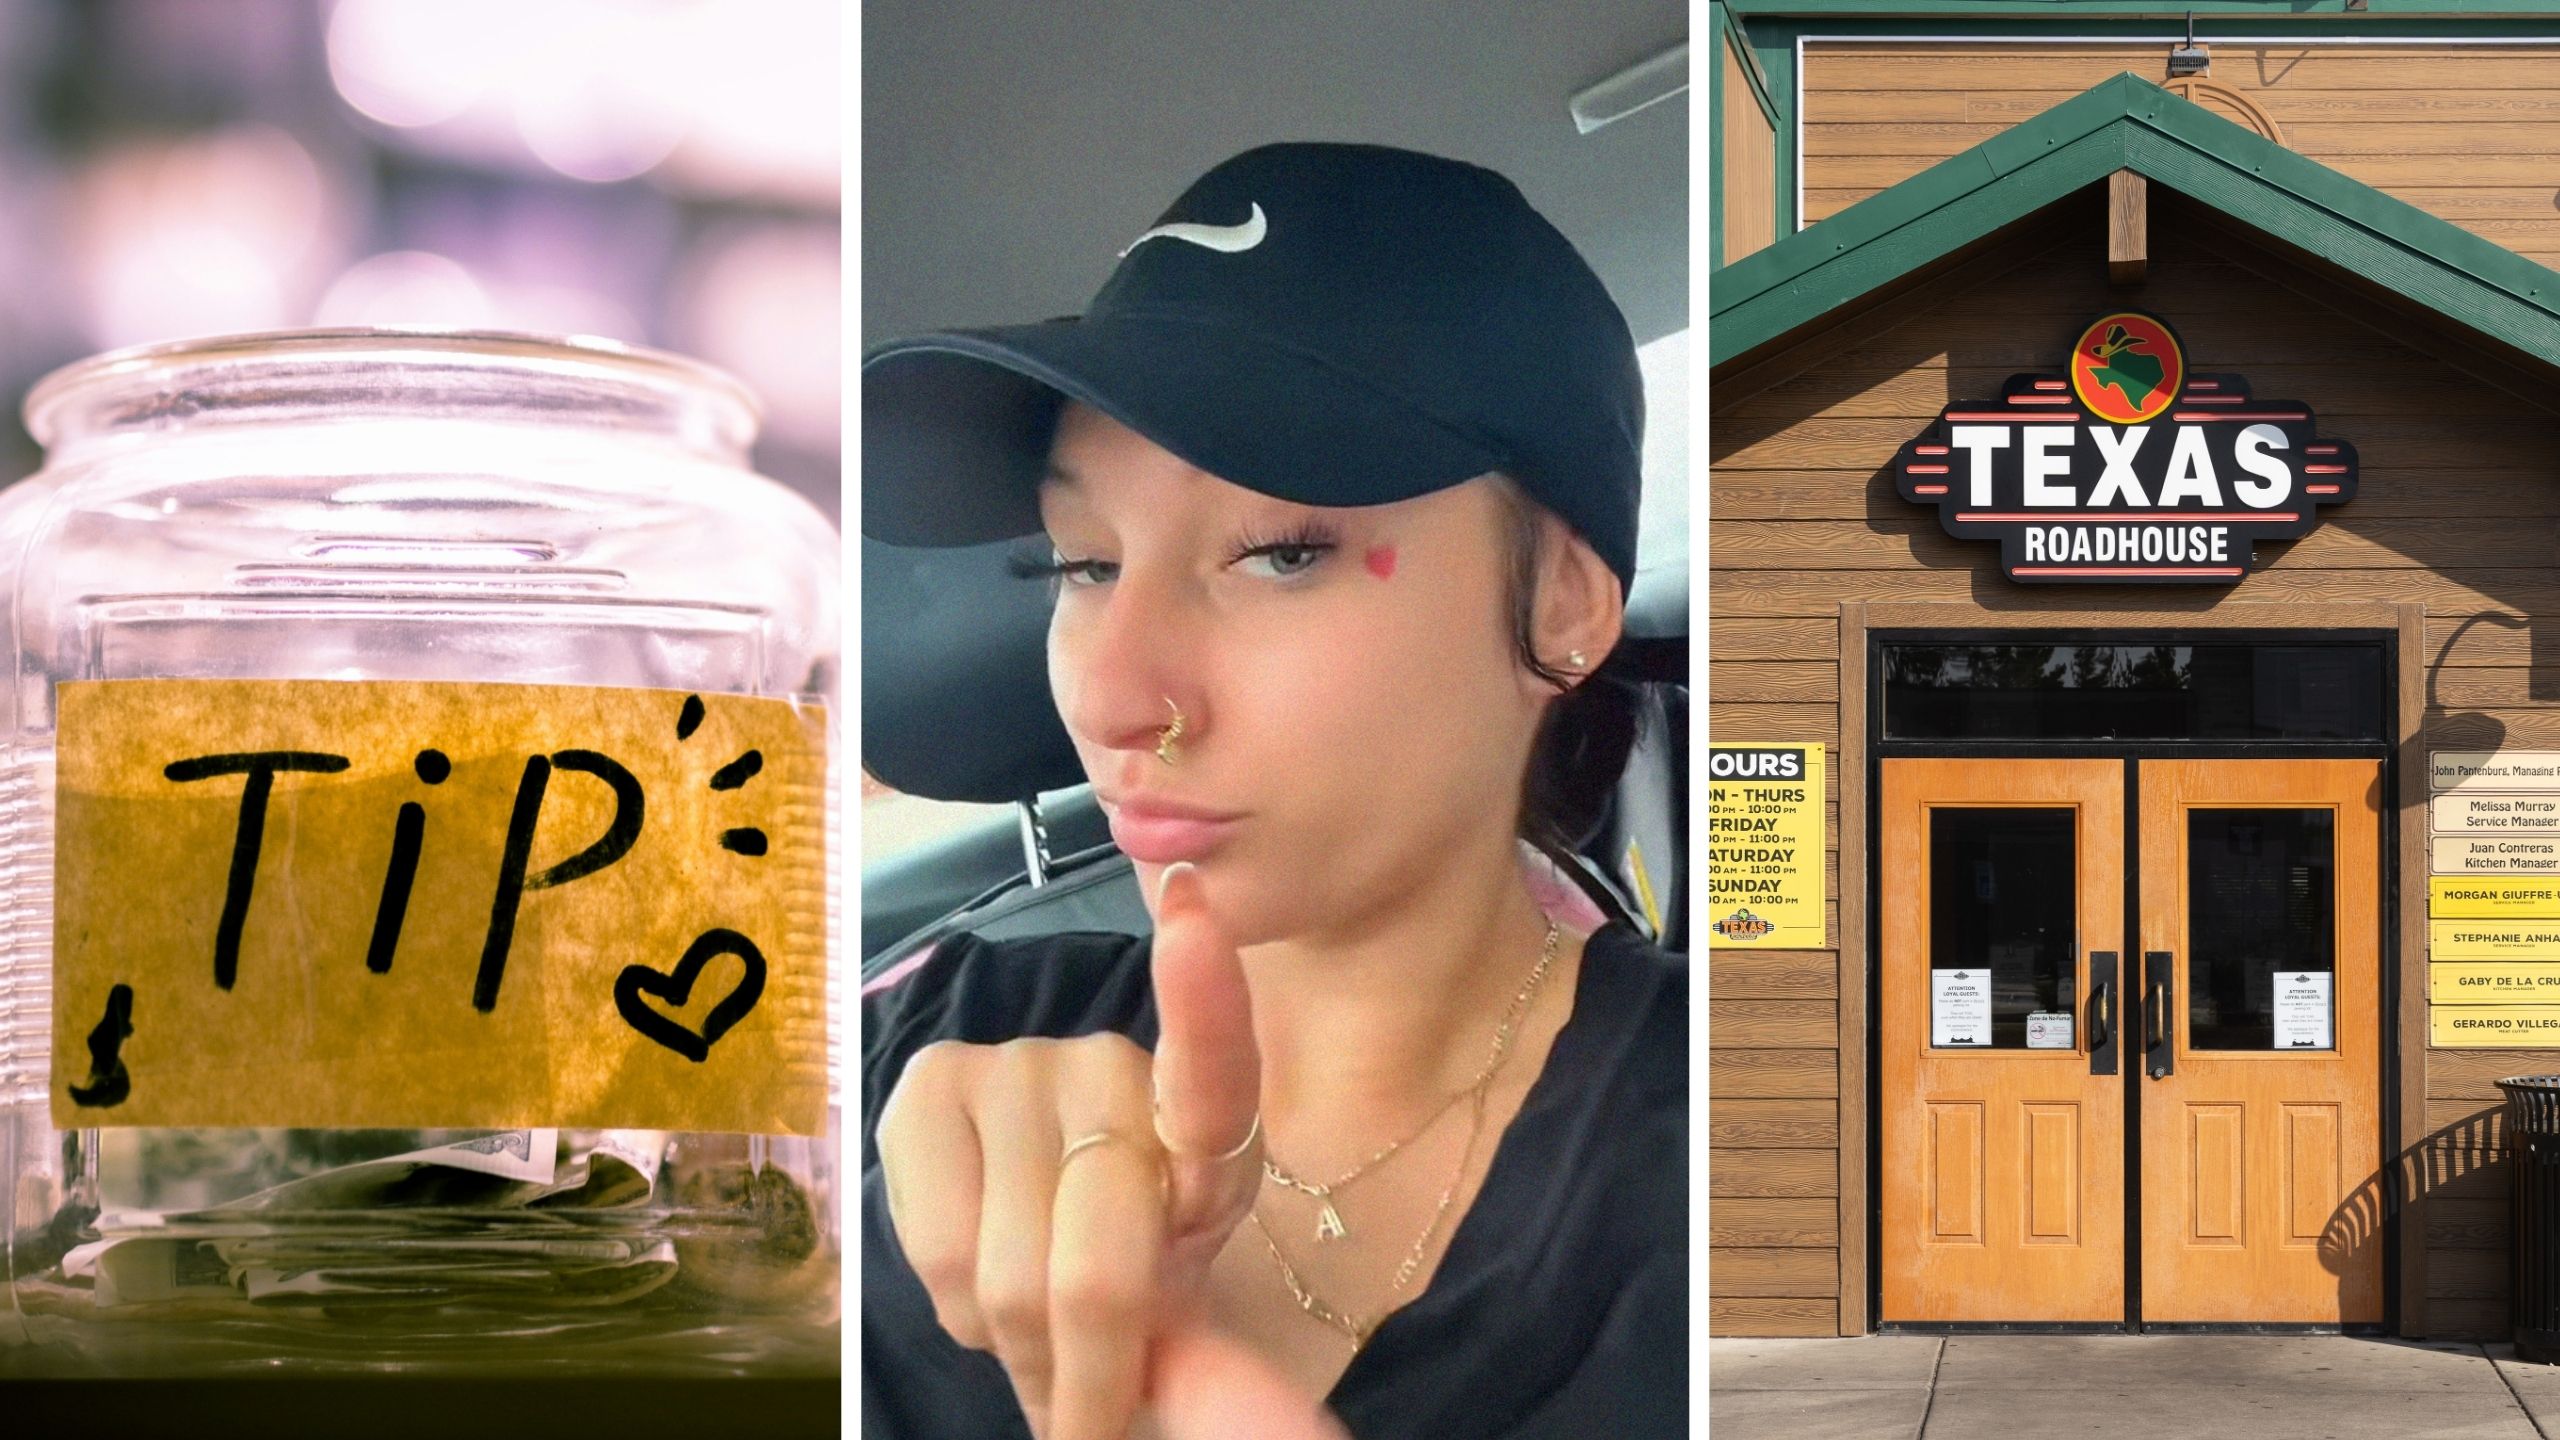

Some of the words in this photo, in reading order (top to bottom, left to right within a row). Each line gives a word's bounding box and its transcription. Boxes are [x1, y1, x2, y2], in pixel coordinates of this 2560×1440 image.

[1952, 424, 2292, 508] TEXAS
[2025, 526, 2228, 562] ROADHOUSE
[1710, 753, 1799, 777] OURS
[2434, 765, 2455, 776] John
[2512, 766, 2554, 776] Managing
[1743, 788, 1806, 803] THURS
[1723, 806, 1736, 814] PM
[1749, 804, 1781, 814] 10:00
[1784, 806, 1797, 814] PM
[2470, 801, 2511, 812] Melissa
[2515, 801, 2556, 812] Murray
[1709, 817, 1778, 832] FRIDAY
[2466, 816, 2508, 827] Service
[2511, 816, 2560, 827] Manager
[1750, 834, 1780, 844] 11:00
[1782, 836, 1796, 844] PM
[2469, 842, 2495, 853] Juan
[2498, 842, 2554, 853] Contreras
[1709, 849, 1795, 863] ATURDAY
[2465, 858, 2506, 868] Kitchen
[2510, 858, 2558, 868] Manager
[1750, 865, 1781, 875] 11:00
[1709, 879, 1782, 893] SUNDAY
[1749, 895, 1783, 905] 10:00
[2444, 890, 2498, 900] MORGAN
[1722, 921, 1766, 934] TEXAS
[2453, 933, 2521, 943] STEPHANIE
[2458, 977, 2492, 986] GABY
[2496, 977, 2512, 986] DE
[2516, 977, 2533, 986] LA
[2453, 1019, 2512, 1029] GERARDO
[2516, 1019, 2560, 1029] VILLEG
